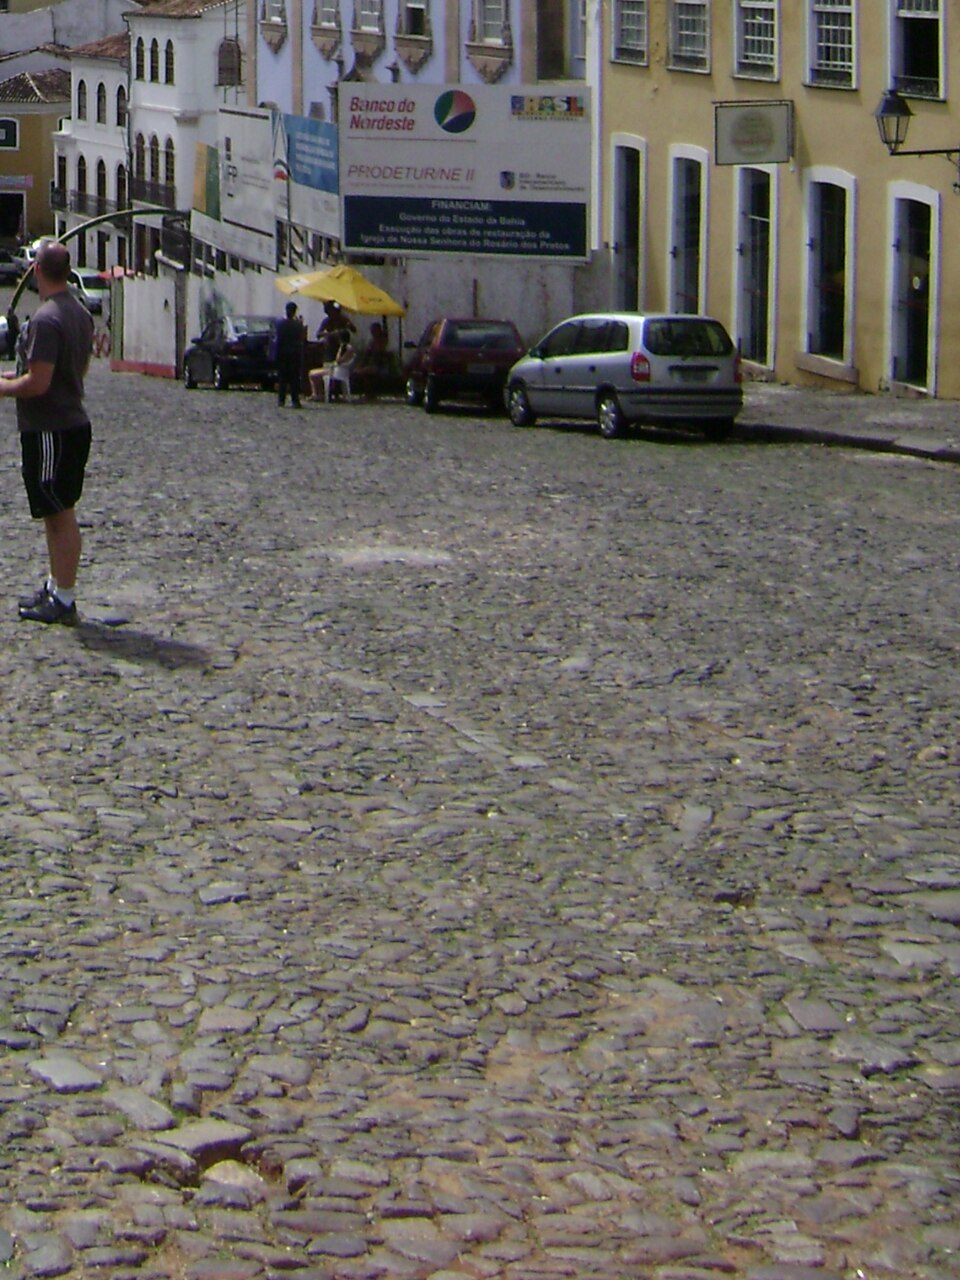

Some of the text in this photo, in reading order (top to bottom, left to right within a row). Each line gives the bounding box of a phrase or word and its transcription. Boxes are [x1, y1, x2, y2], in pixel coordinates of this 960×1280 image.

[350, 96, 416, 113] Banco do
[349, 114, 416, 131] Nordeste
[399, 212, 526, 226] Governo do Estado da Bahia
[540, 241, 571, 250] Pretos
